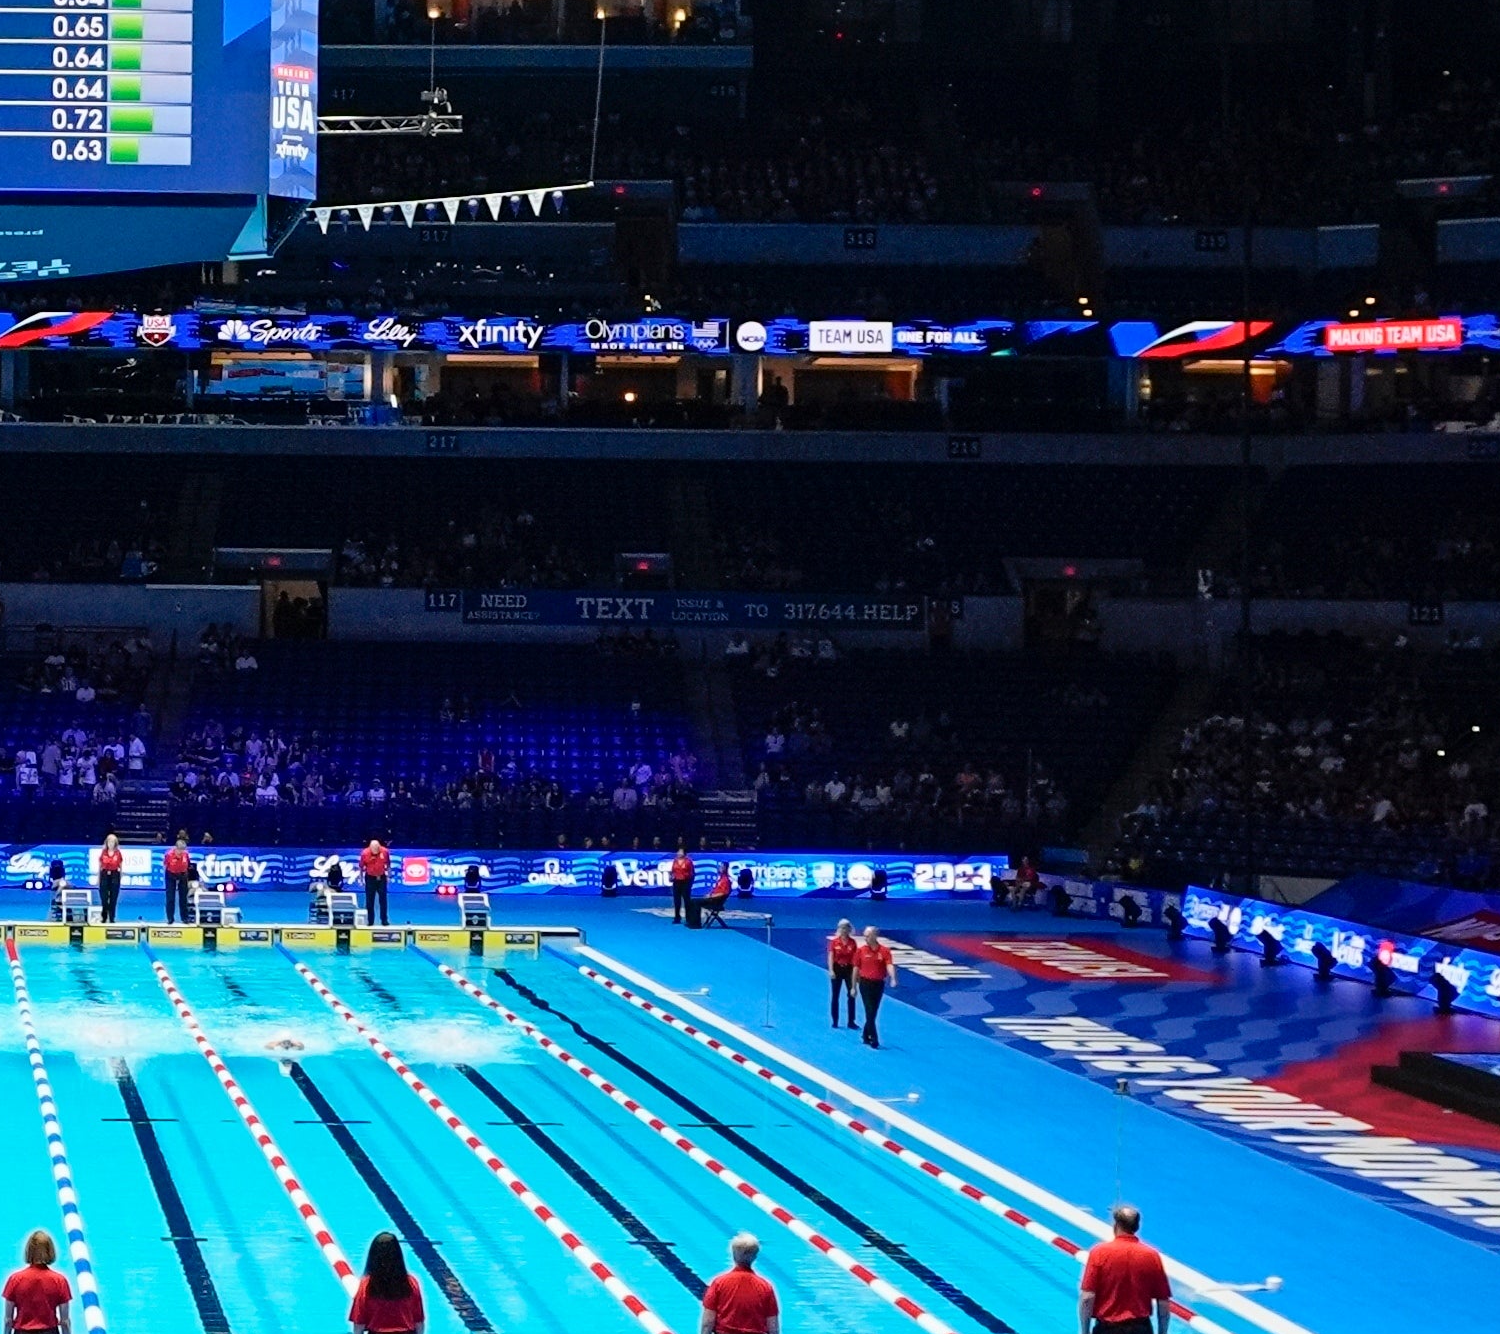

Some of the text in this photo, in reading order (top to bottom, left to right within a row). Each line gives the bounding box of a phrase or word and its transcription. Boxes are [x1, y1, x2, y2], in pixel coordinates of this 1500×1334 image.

[52, 15, 105, 38] 0.65
[51, 46, 105, 69] 0.64
[51, 77, 105, 100] 0.64
[51, 108, 104, 131] 0.72
[271, 96, 316, 135] USA
[50, 138, 103, 161] 0.63
[248, 317, 321, 343] Sports
[362, 317, 418, 348] Lilly
[458, 318, 545, 349] xfinity
[584, 318, 687, 344] Olympians
[817, 328, 885, 346] TEAM USA
[897, 330, 981, 345] ONE FOR ALL
[1329, 324, 1424, 347] MAKING TEAM
[427, 593, 458, 609] 117
[480, 594, 529, 609] NEED
[575, 597, 655, 621] TEXT
[744, 603, 769, 618] TO
[527, 870, 577, 887] OMEGA
[912, 861, 993, 892] 2024
[981, 1016, 1168, 1054] THIS
